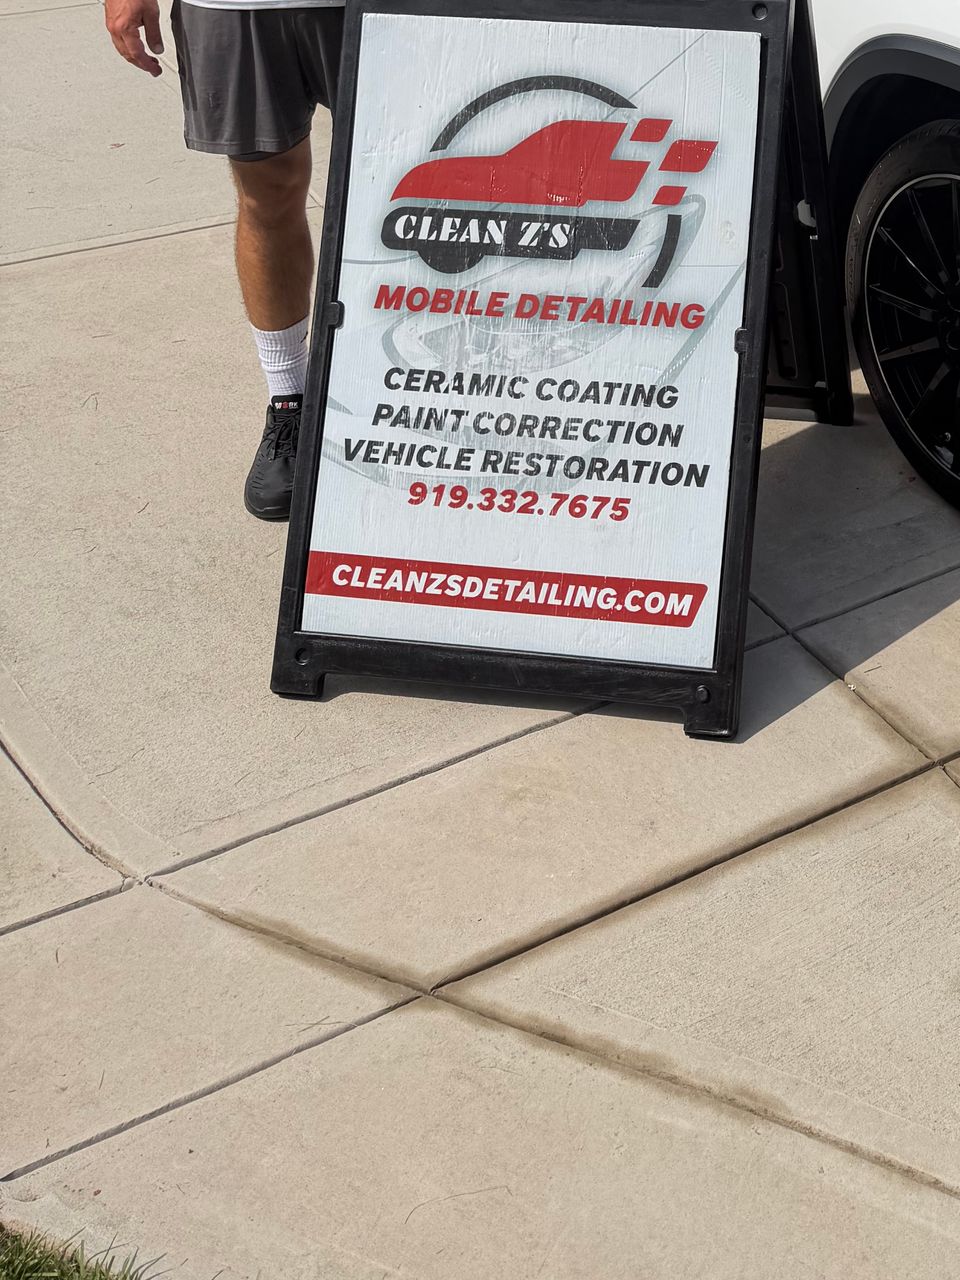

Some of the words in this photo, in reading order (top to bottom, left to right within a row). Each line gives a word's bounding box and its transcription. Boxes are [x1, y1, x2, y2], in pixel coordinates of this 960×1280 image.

[395, 214, 507, 247] CLEAN
[518, 222, 571, 249] Z'S
[374, 285, 509, 317] MOBILE
[514, 293, 705, 329] DETAILING
[384, 367, 529, 400] CERAMIC
[536, 377, 679, 409] COATING
[371, 404, 468, 433] PAINT
[473, 412, 684, 448] CORRECTION
[344, 438, 474, 472] VEHICLE
[480, 450, 711, 488] RESTORATION
[408, 482, 631, 521] 919.332.7675
[332, 564, 694, 616] CLEANZSDETAILING.COM
